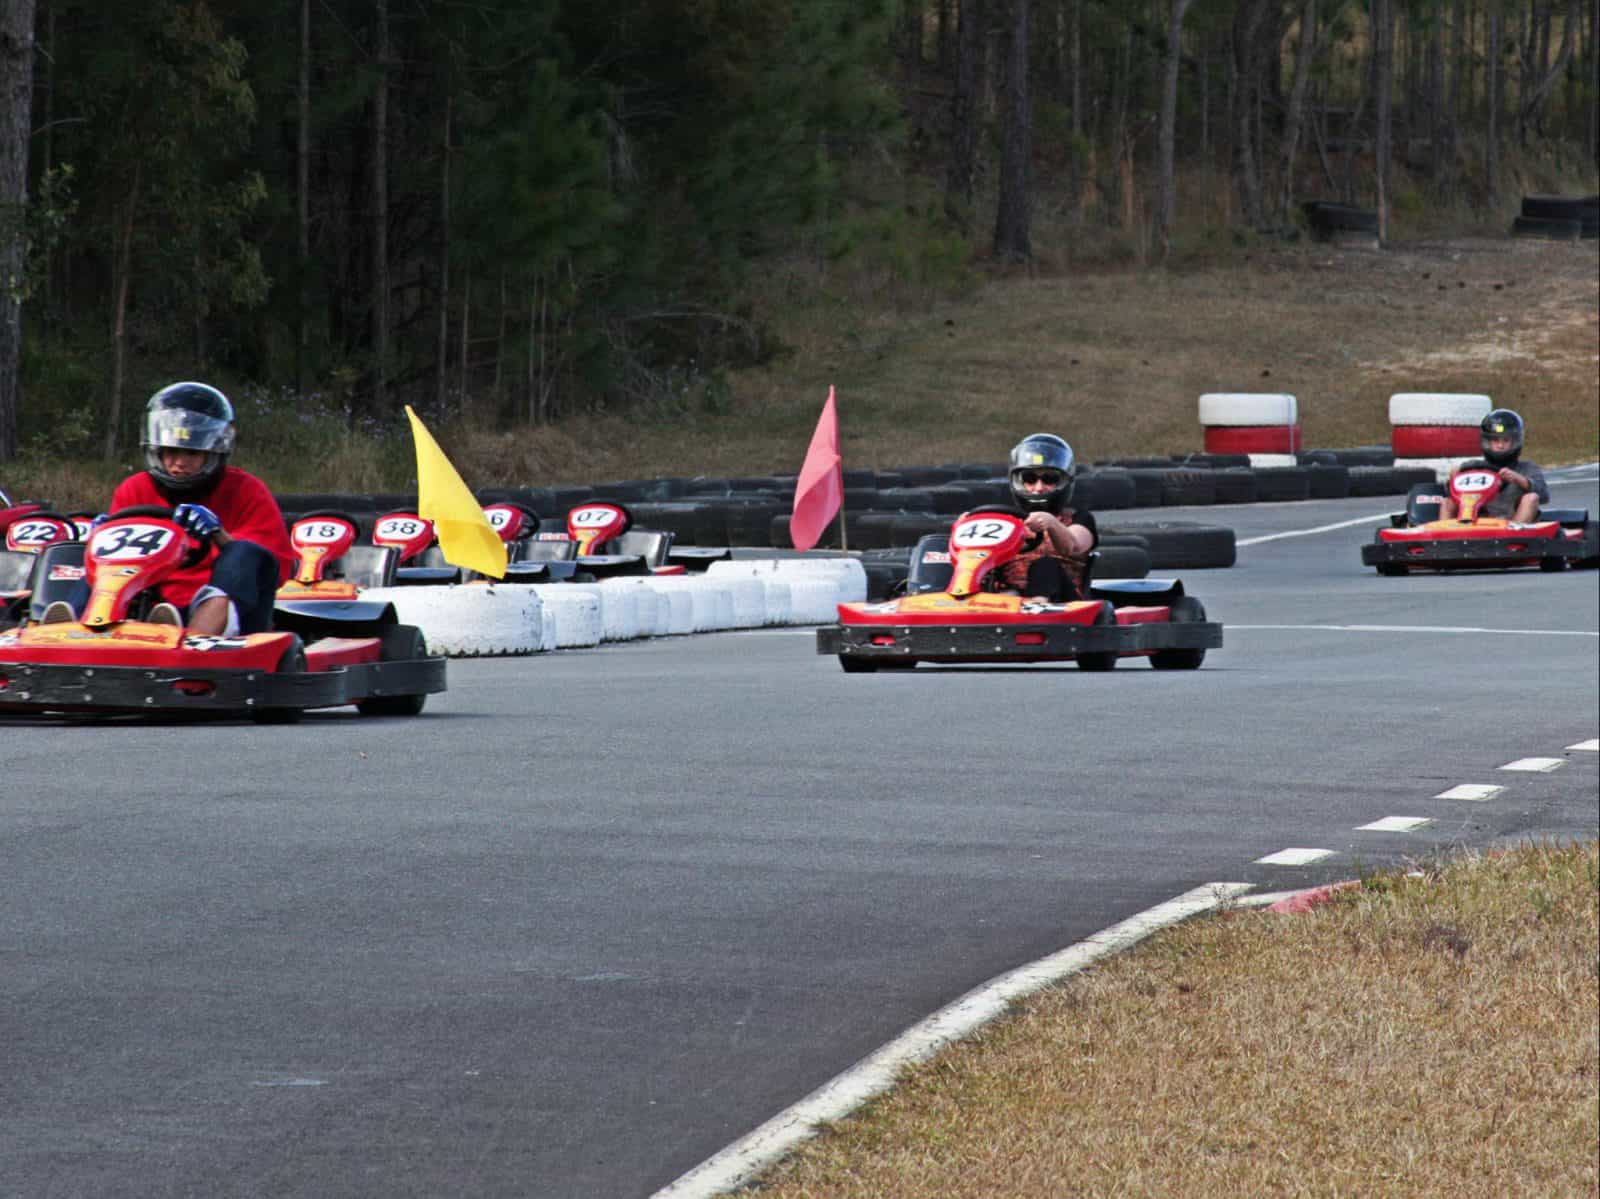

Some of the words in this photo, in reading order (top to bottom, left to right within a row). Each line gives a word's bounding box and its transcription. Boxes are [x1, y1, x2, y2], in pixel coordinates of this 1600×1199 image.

[1458, 476, 1487, 486] 44
[490, 512, 504, 526] 6
[577, 511, 610, 523] 07
[15, 524, 58, 541] 22
[304, 525, 336, 538] 18
[382, 521, 417, 535] 38
[959, 523, 1004, 539] 42
[95, 527, 169, 556] 34
